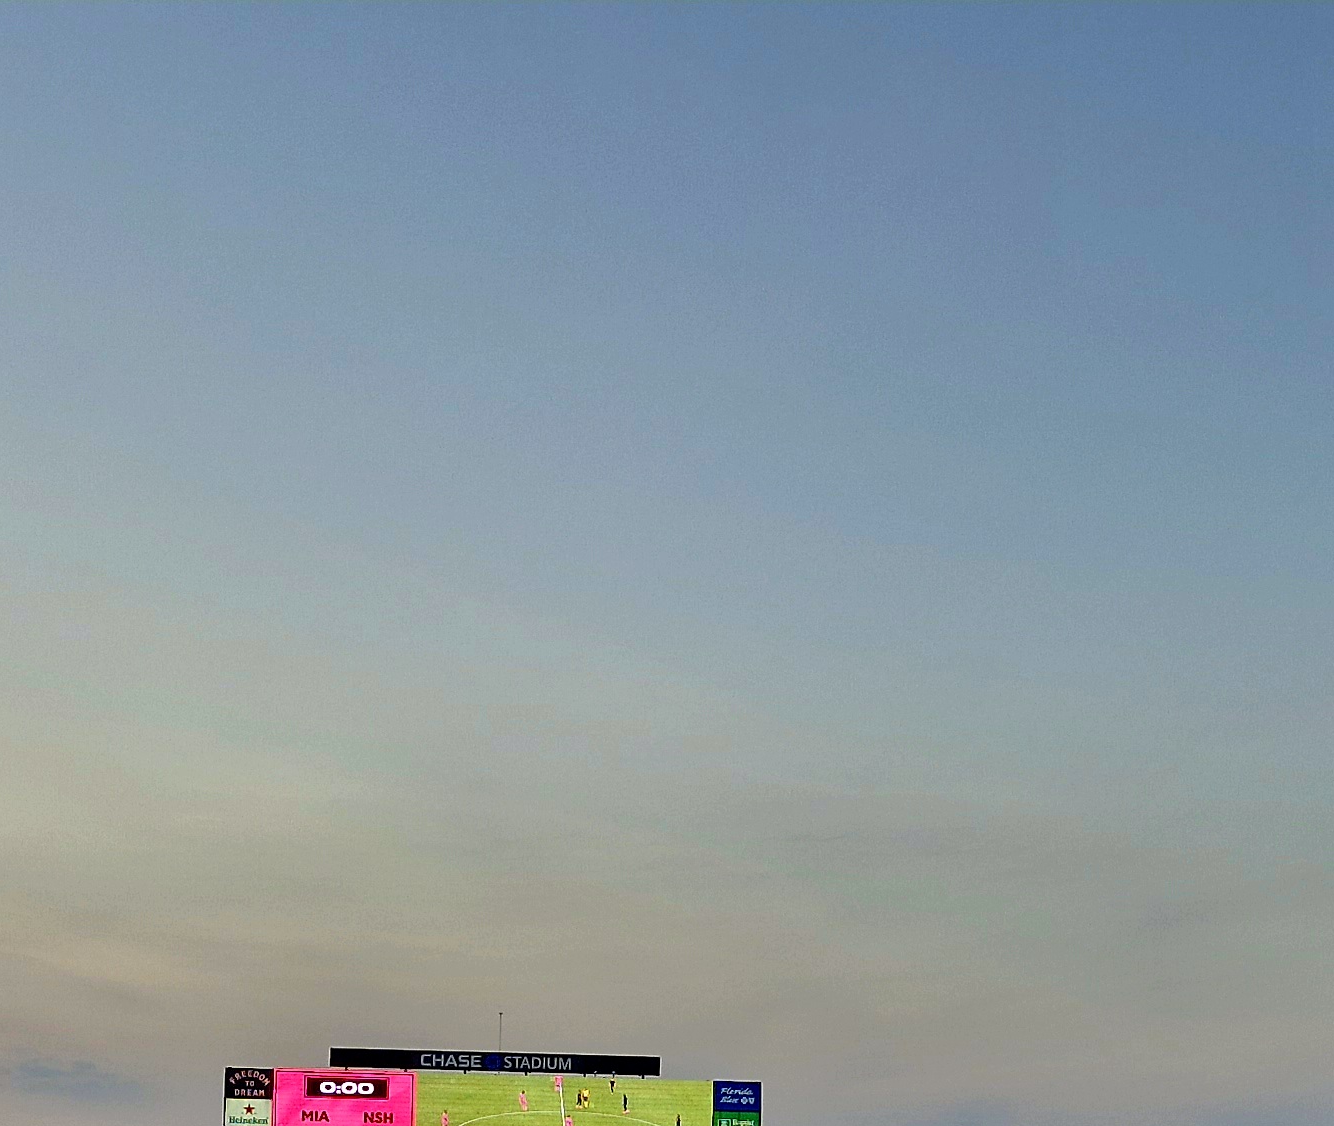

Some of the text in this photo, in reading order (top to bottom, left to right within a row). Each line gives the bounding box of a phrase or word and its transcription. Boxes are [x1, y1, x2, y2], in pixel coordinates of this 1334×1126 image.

[420, 1053, 572, 1070] CHASE STADIUM
[234, 1088, 265, 1097] DREAM
[319, 1081, 375, 1095] 0:00
[301, 1110, 330, 1122] MIA
[363, 1112, 394, 1124] NSH
